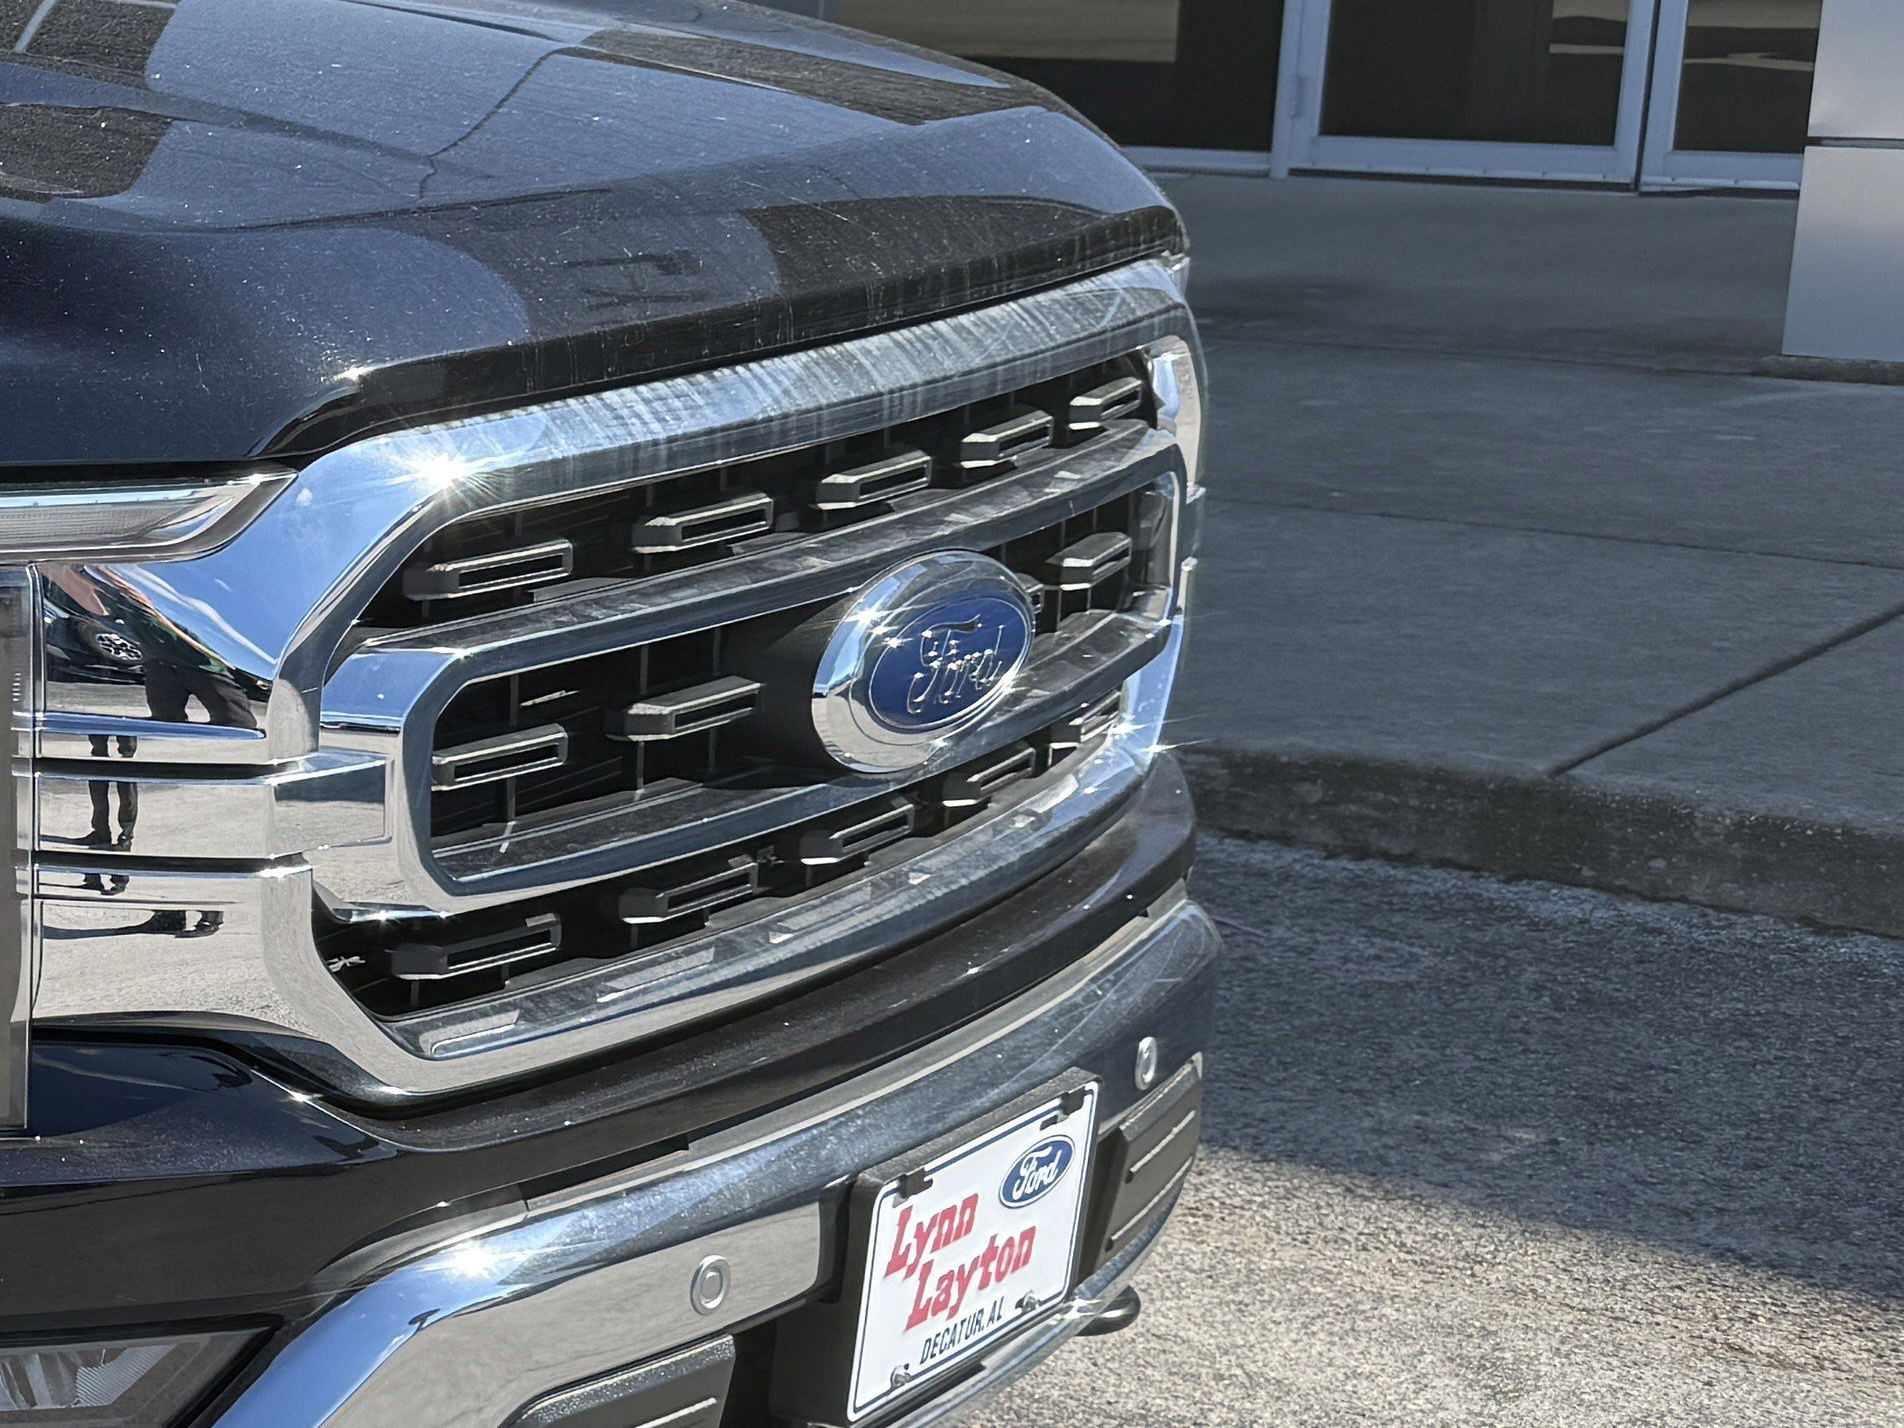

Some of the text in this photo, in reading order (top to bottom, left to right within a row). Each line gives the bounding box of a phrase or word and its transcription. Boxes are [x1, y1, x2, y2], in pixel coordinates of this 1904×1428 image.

[906, 613, 1006, 715] Ford
[1012, 1145, 1063, 1201] Ford
[882, 1192, 979, 1281] Lynn
[903, 1224, 1037, 1333] Layton
[986, 1295, 1005, 1328] AL
